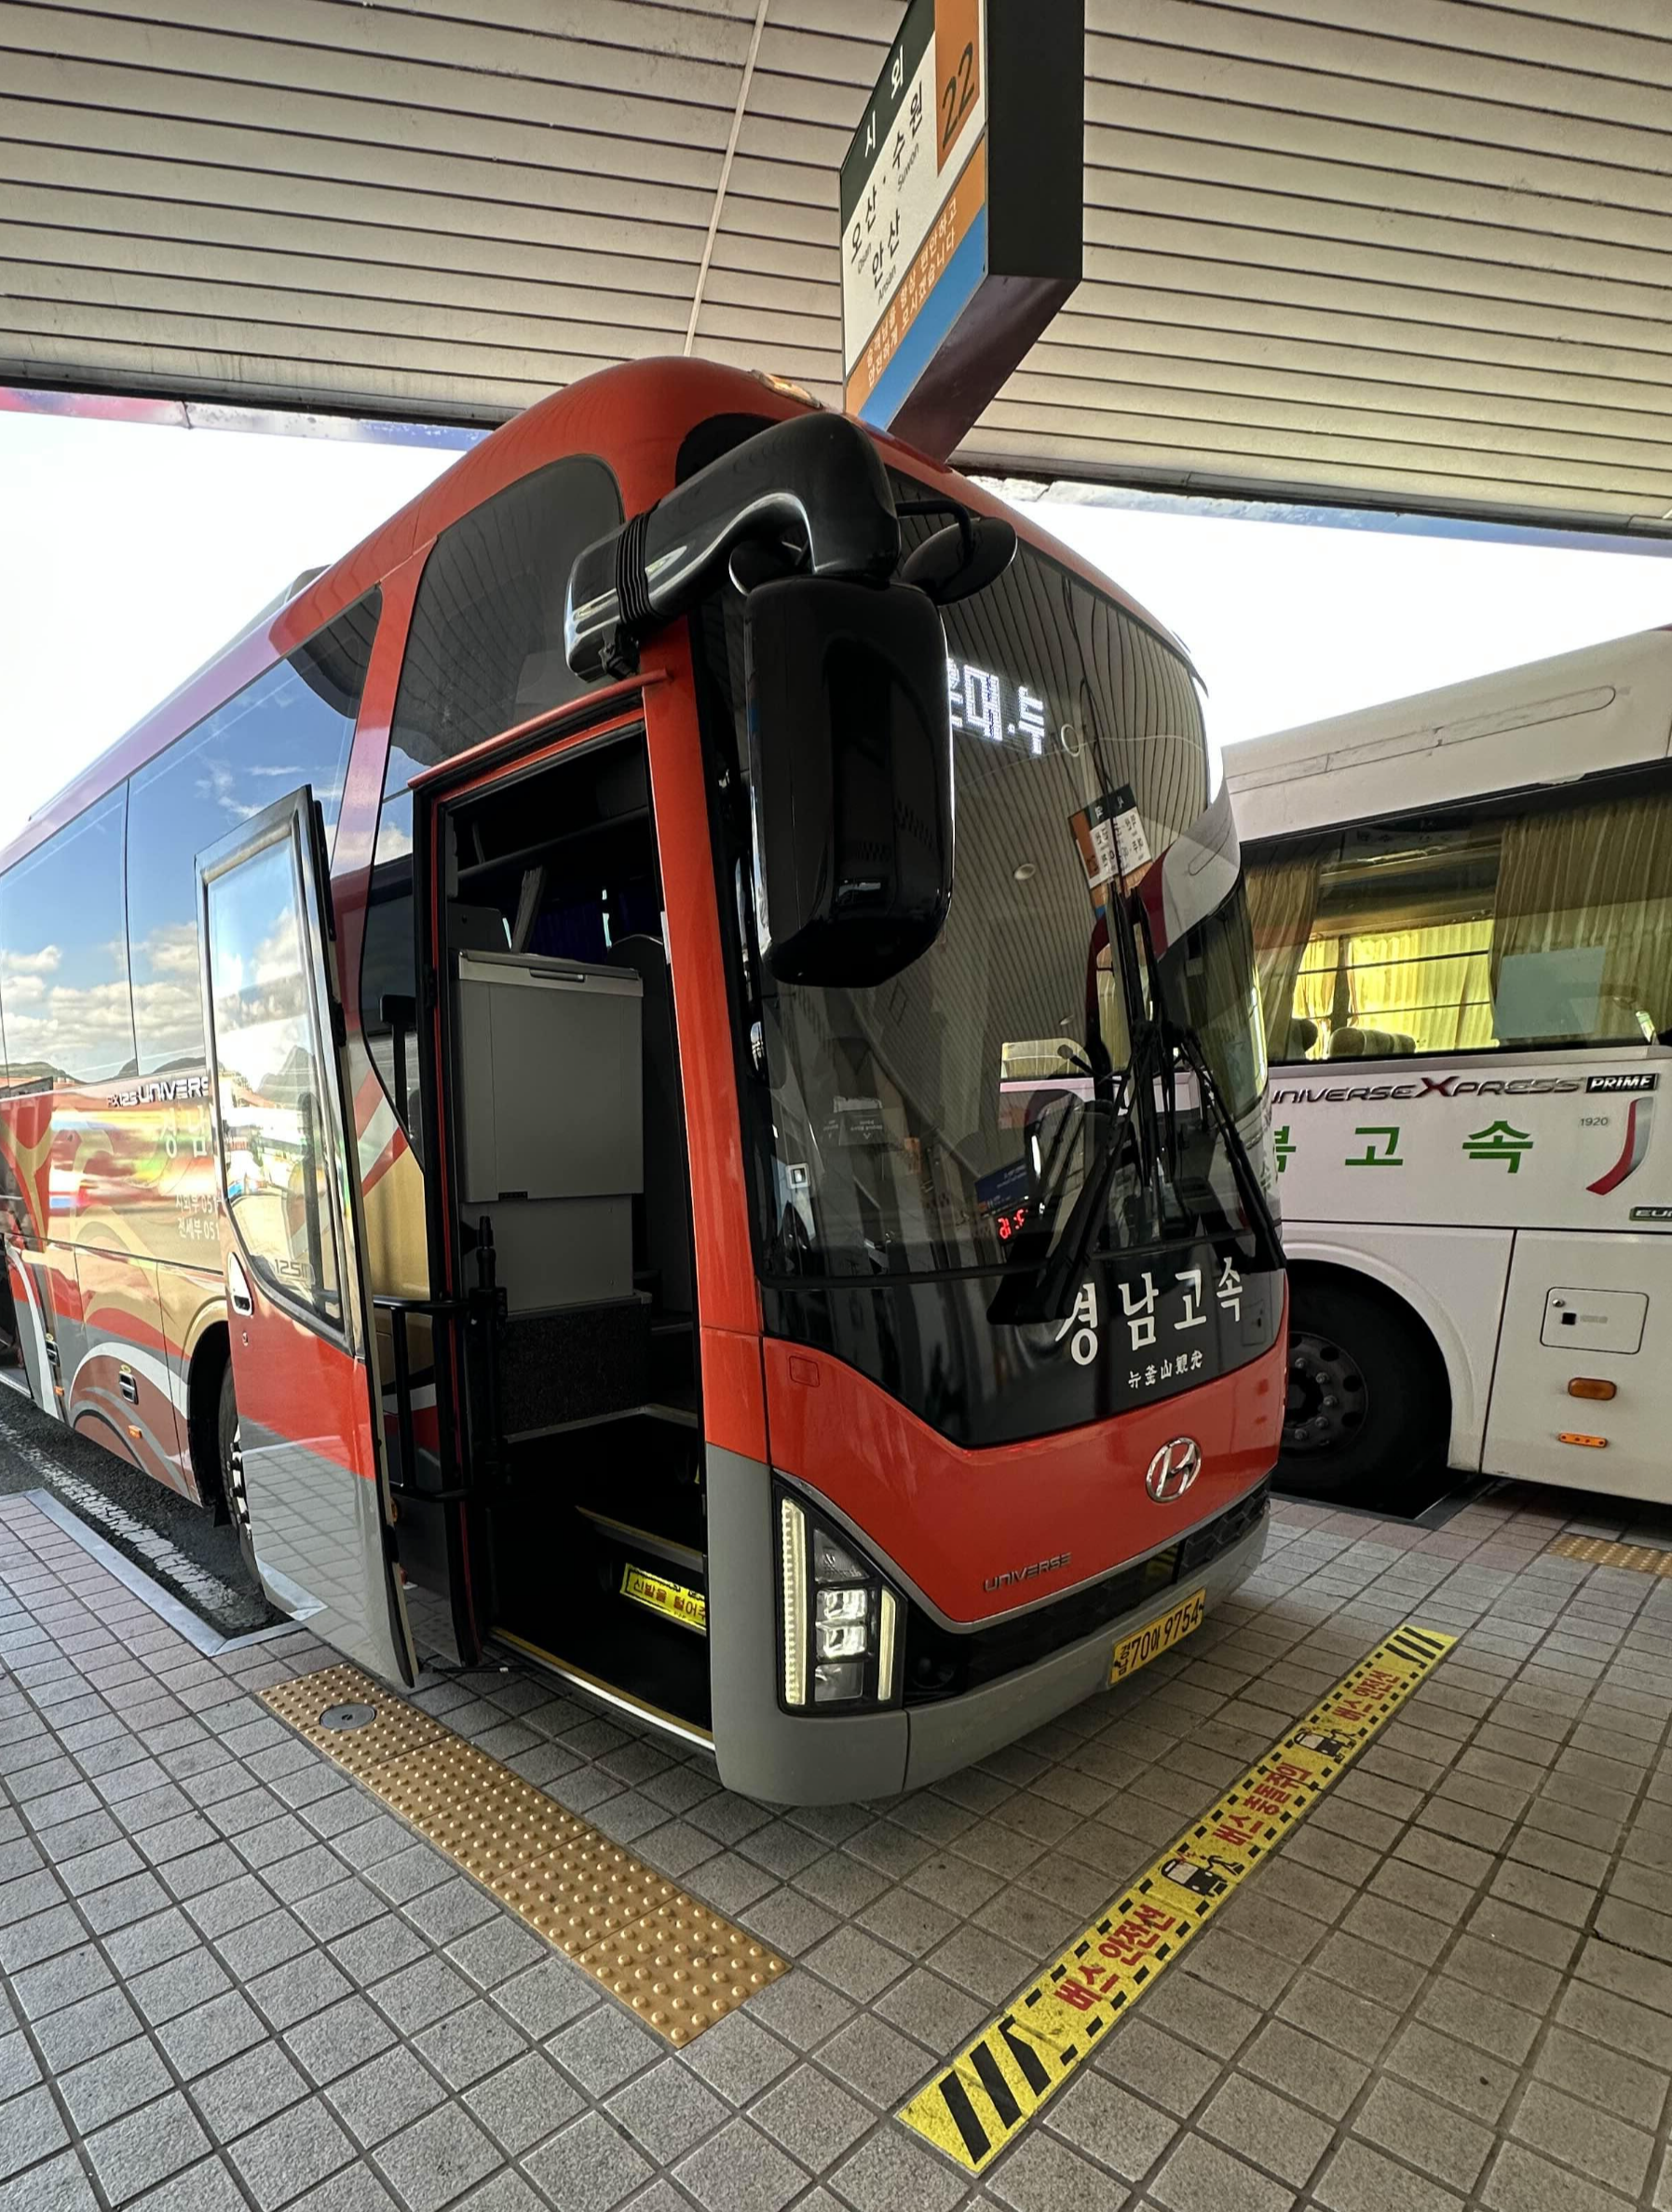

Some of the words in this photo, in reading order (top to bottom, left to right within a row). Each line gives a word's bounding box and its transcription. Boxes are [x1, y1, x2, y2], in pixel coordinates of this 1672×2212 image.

[864, 44, 904, 158] 시외
[941, 41, 975, 150] 22
[898, 142, 919, 192] Suwon
[858, 242, 872, 274] Osan
[872, 208, 900, 290] 안산
[878, 265, 896, 305] Ansan
[900, 268, 916, 309] 항상
[919, 197, 958, 273] 편안하고
[868, 324, 898, 388] 안전하게
[902, 227, 956, 332] 모시겠습니다
[1590, 1075, 1654, 1090] PRIME
[1581, 1116, 1609, 1127] 1920
[1054, 1256, 1244, 1366] 경남고속
[983, 1552, 1071, 1593] UNIVERSE
[1131, 1625, 1162, 1669] 70아
[1164, 1597, 1200, 1646] 9754
[1332, 1700, 1373, 1721] 버스
[1353, 1669, 1401, 1701] 안전선
[1212, 1814, 1264, 1847] 버스
[1243, 1761, 1312, 1815] 충돌주의
[1053, 1964, 1121, 2011] 버스
[1098, 1903, 1176, 1966] 안전선
